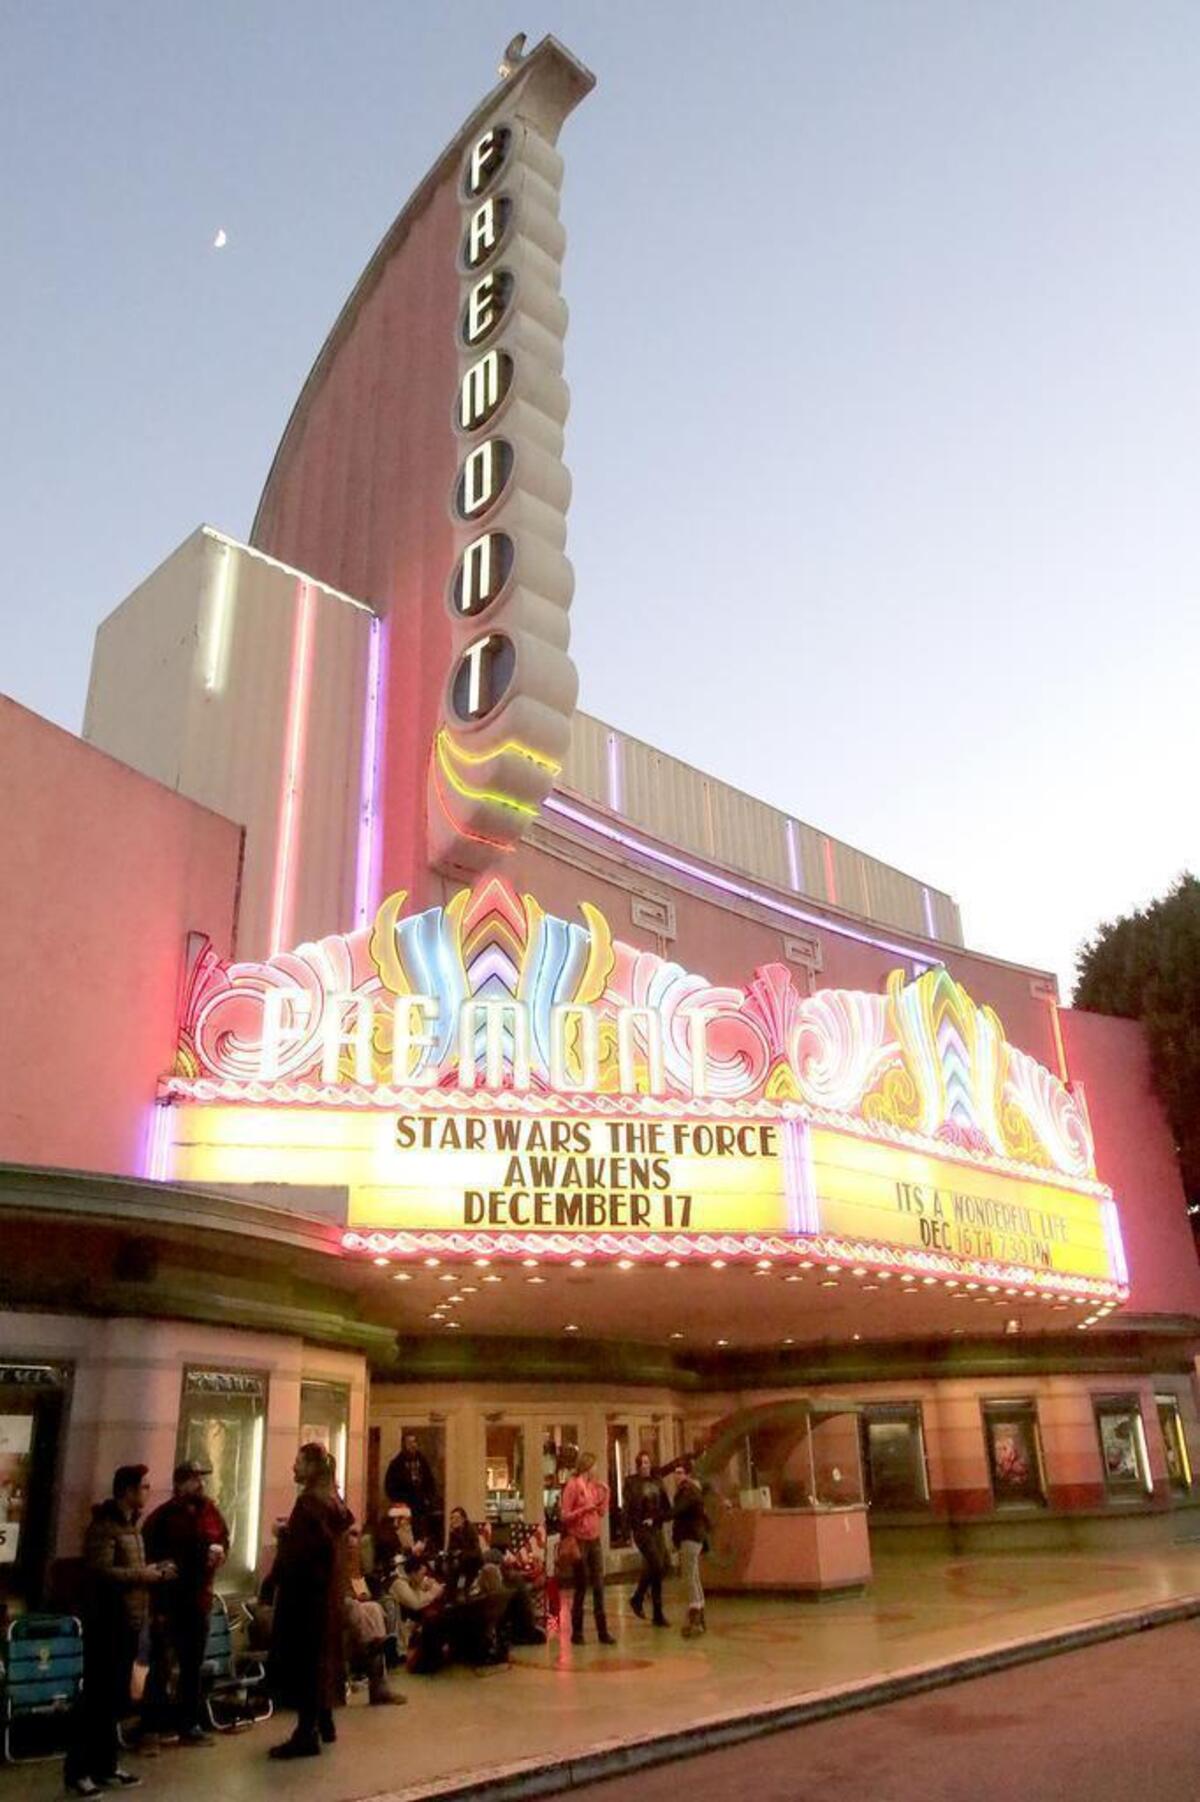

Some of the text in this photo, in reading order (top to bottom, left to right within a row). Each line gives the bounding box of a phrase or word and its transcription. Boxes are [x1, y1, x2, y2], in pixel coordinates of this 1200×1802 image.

[460, 130, 498, 714] FREMONT
[259, 986, 724, 1098] FREMONT
[396, 1115, 779, 1157] STAR WARS THE FORCE
[503, 1155, 672, 1191] AWAKENS
[463, 1190, 693, 1228] DECEMBER 17
[895, 1181, 925, 1216] ITS
[932, 1187, 944, 1219] A
[918, 1216, 953, 1252] DEC
